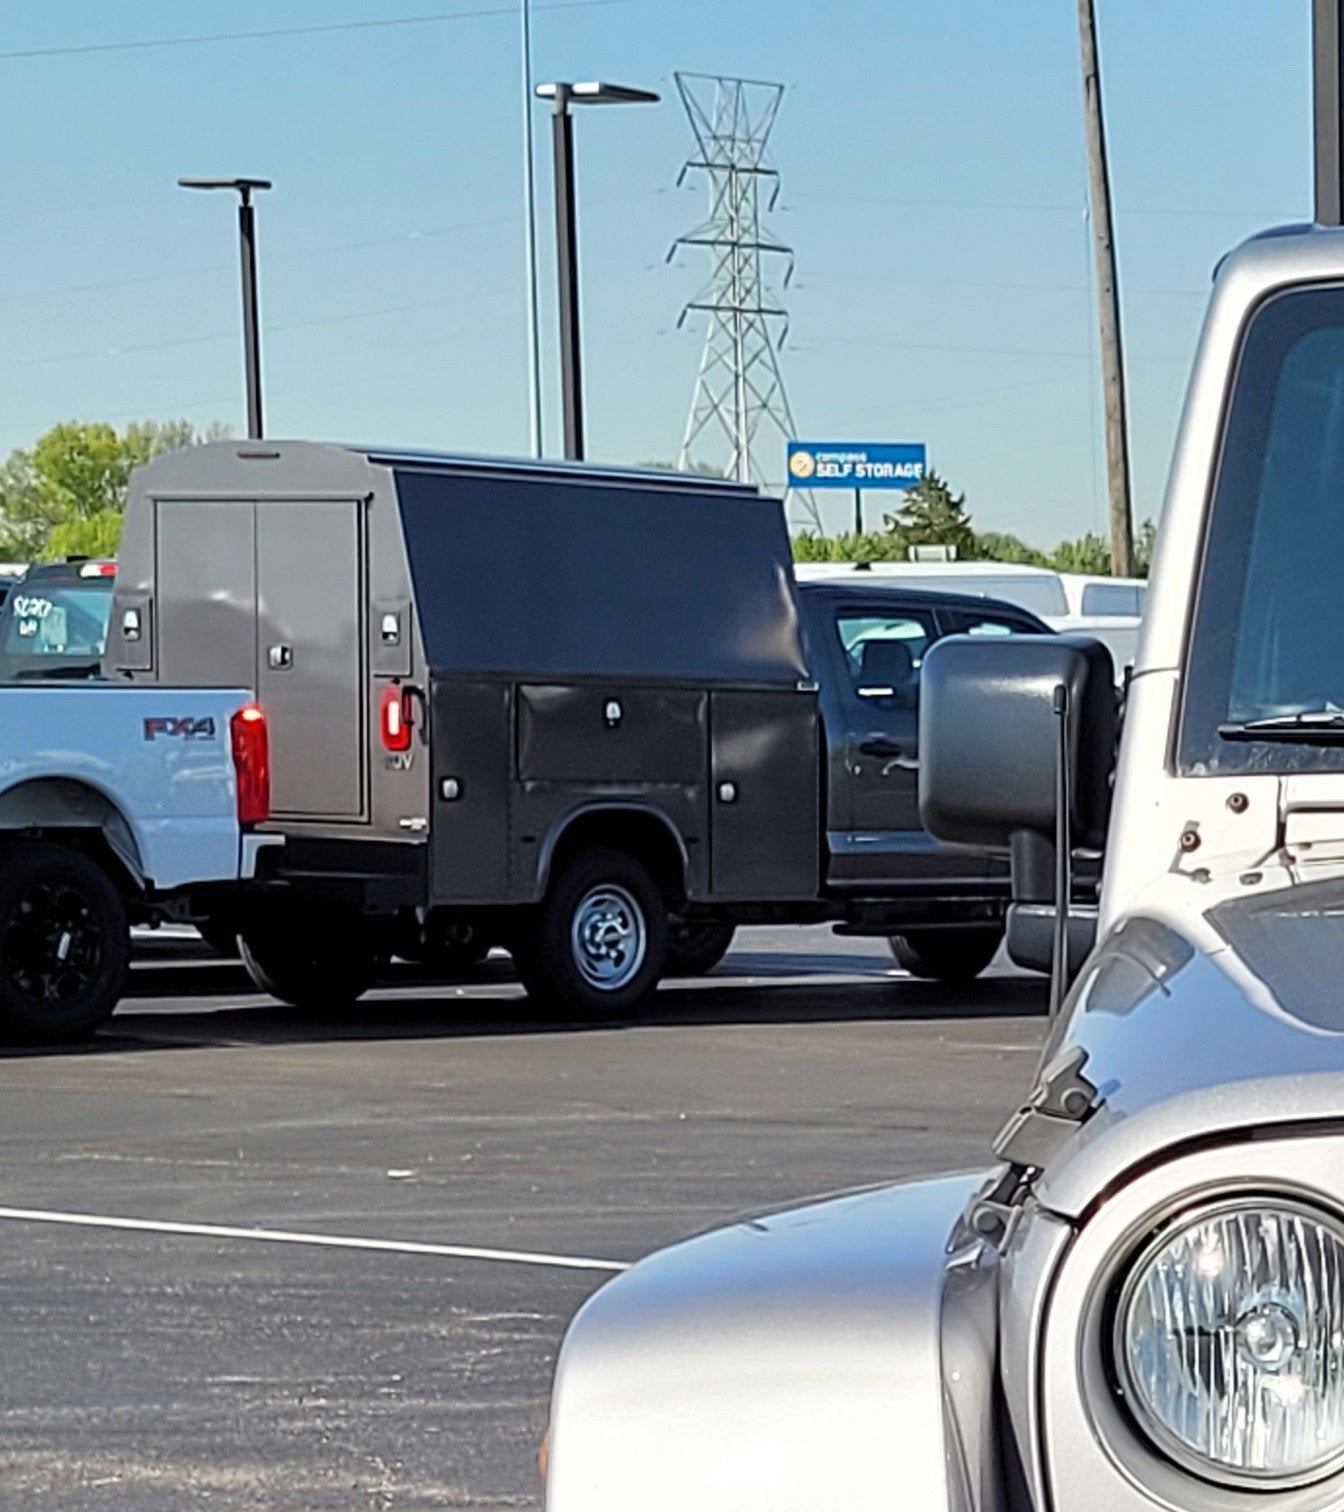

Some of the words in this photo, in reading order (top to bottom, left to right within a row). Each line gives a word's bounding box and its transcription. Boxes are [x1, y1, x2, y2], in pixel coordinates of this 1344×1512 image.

[816, 463, 851, 477] SELF
[855, 463, 923, 478] STORAGE
[143, 717, 216, 741] FX4
